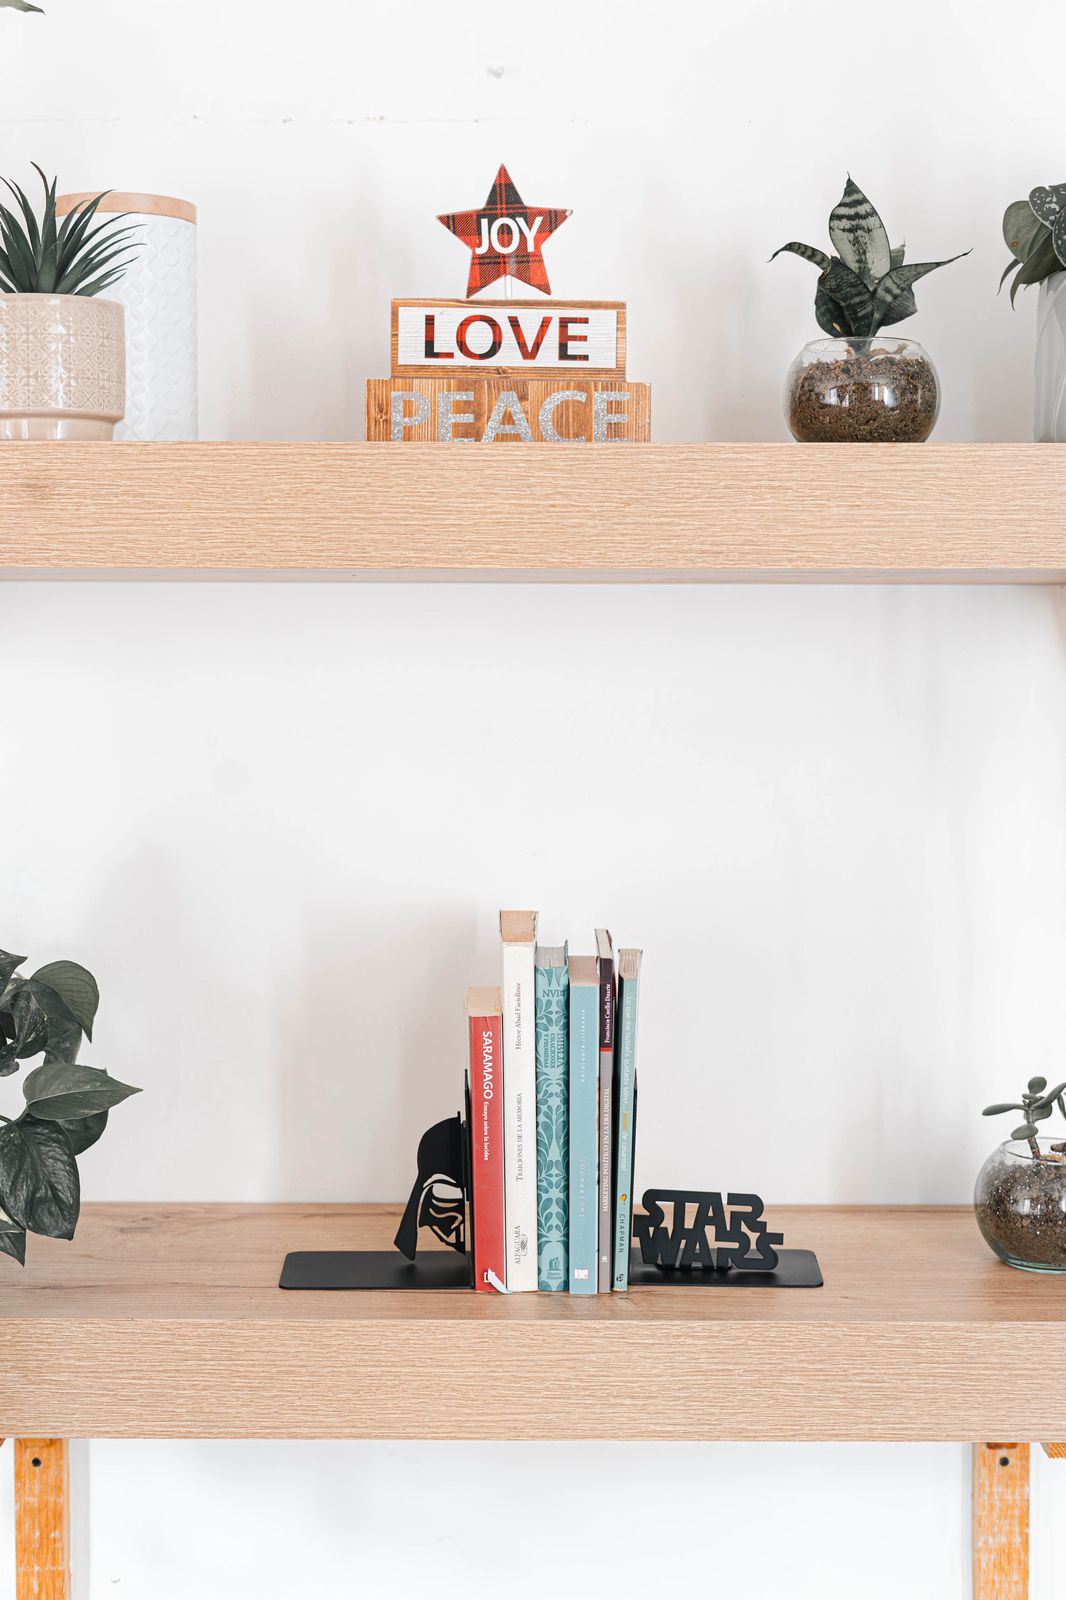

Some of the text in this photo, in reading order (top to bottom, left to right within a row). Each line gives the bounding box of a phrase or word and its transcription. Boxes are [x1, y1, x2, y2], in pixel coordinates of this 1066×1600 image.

[475, 216, 543, 254] JOY
[424, 314, 589, 361] LOVE
[390, 390, 630, 442] PEACE
[626, 997, 632, 1005] Lo
[625, 1020, 631, 1031] me
[482, 1031, 494, 1099] SARAMAGO
[557, 1033, 565, 1068] BIBLIA
[517, 1124, 523, 1132] LA
[517, 1134, 523, 1142] DE
[603, 1135, 609, 1143] EN
[633, 1189, 767, 1236] STAR
[638, 1226, 784, 1270] WARS
